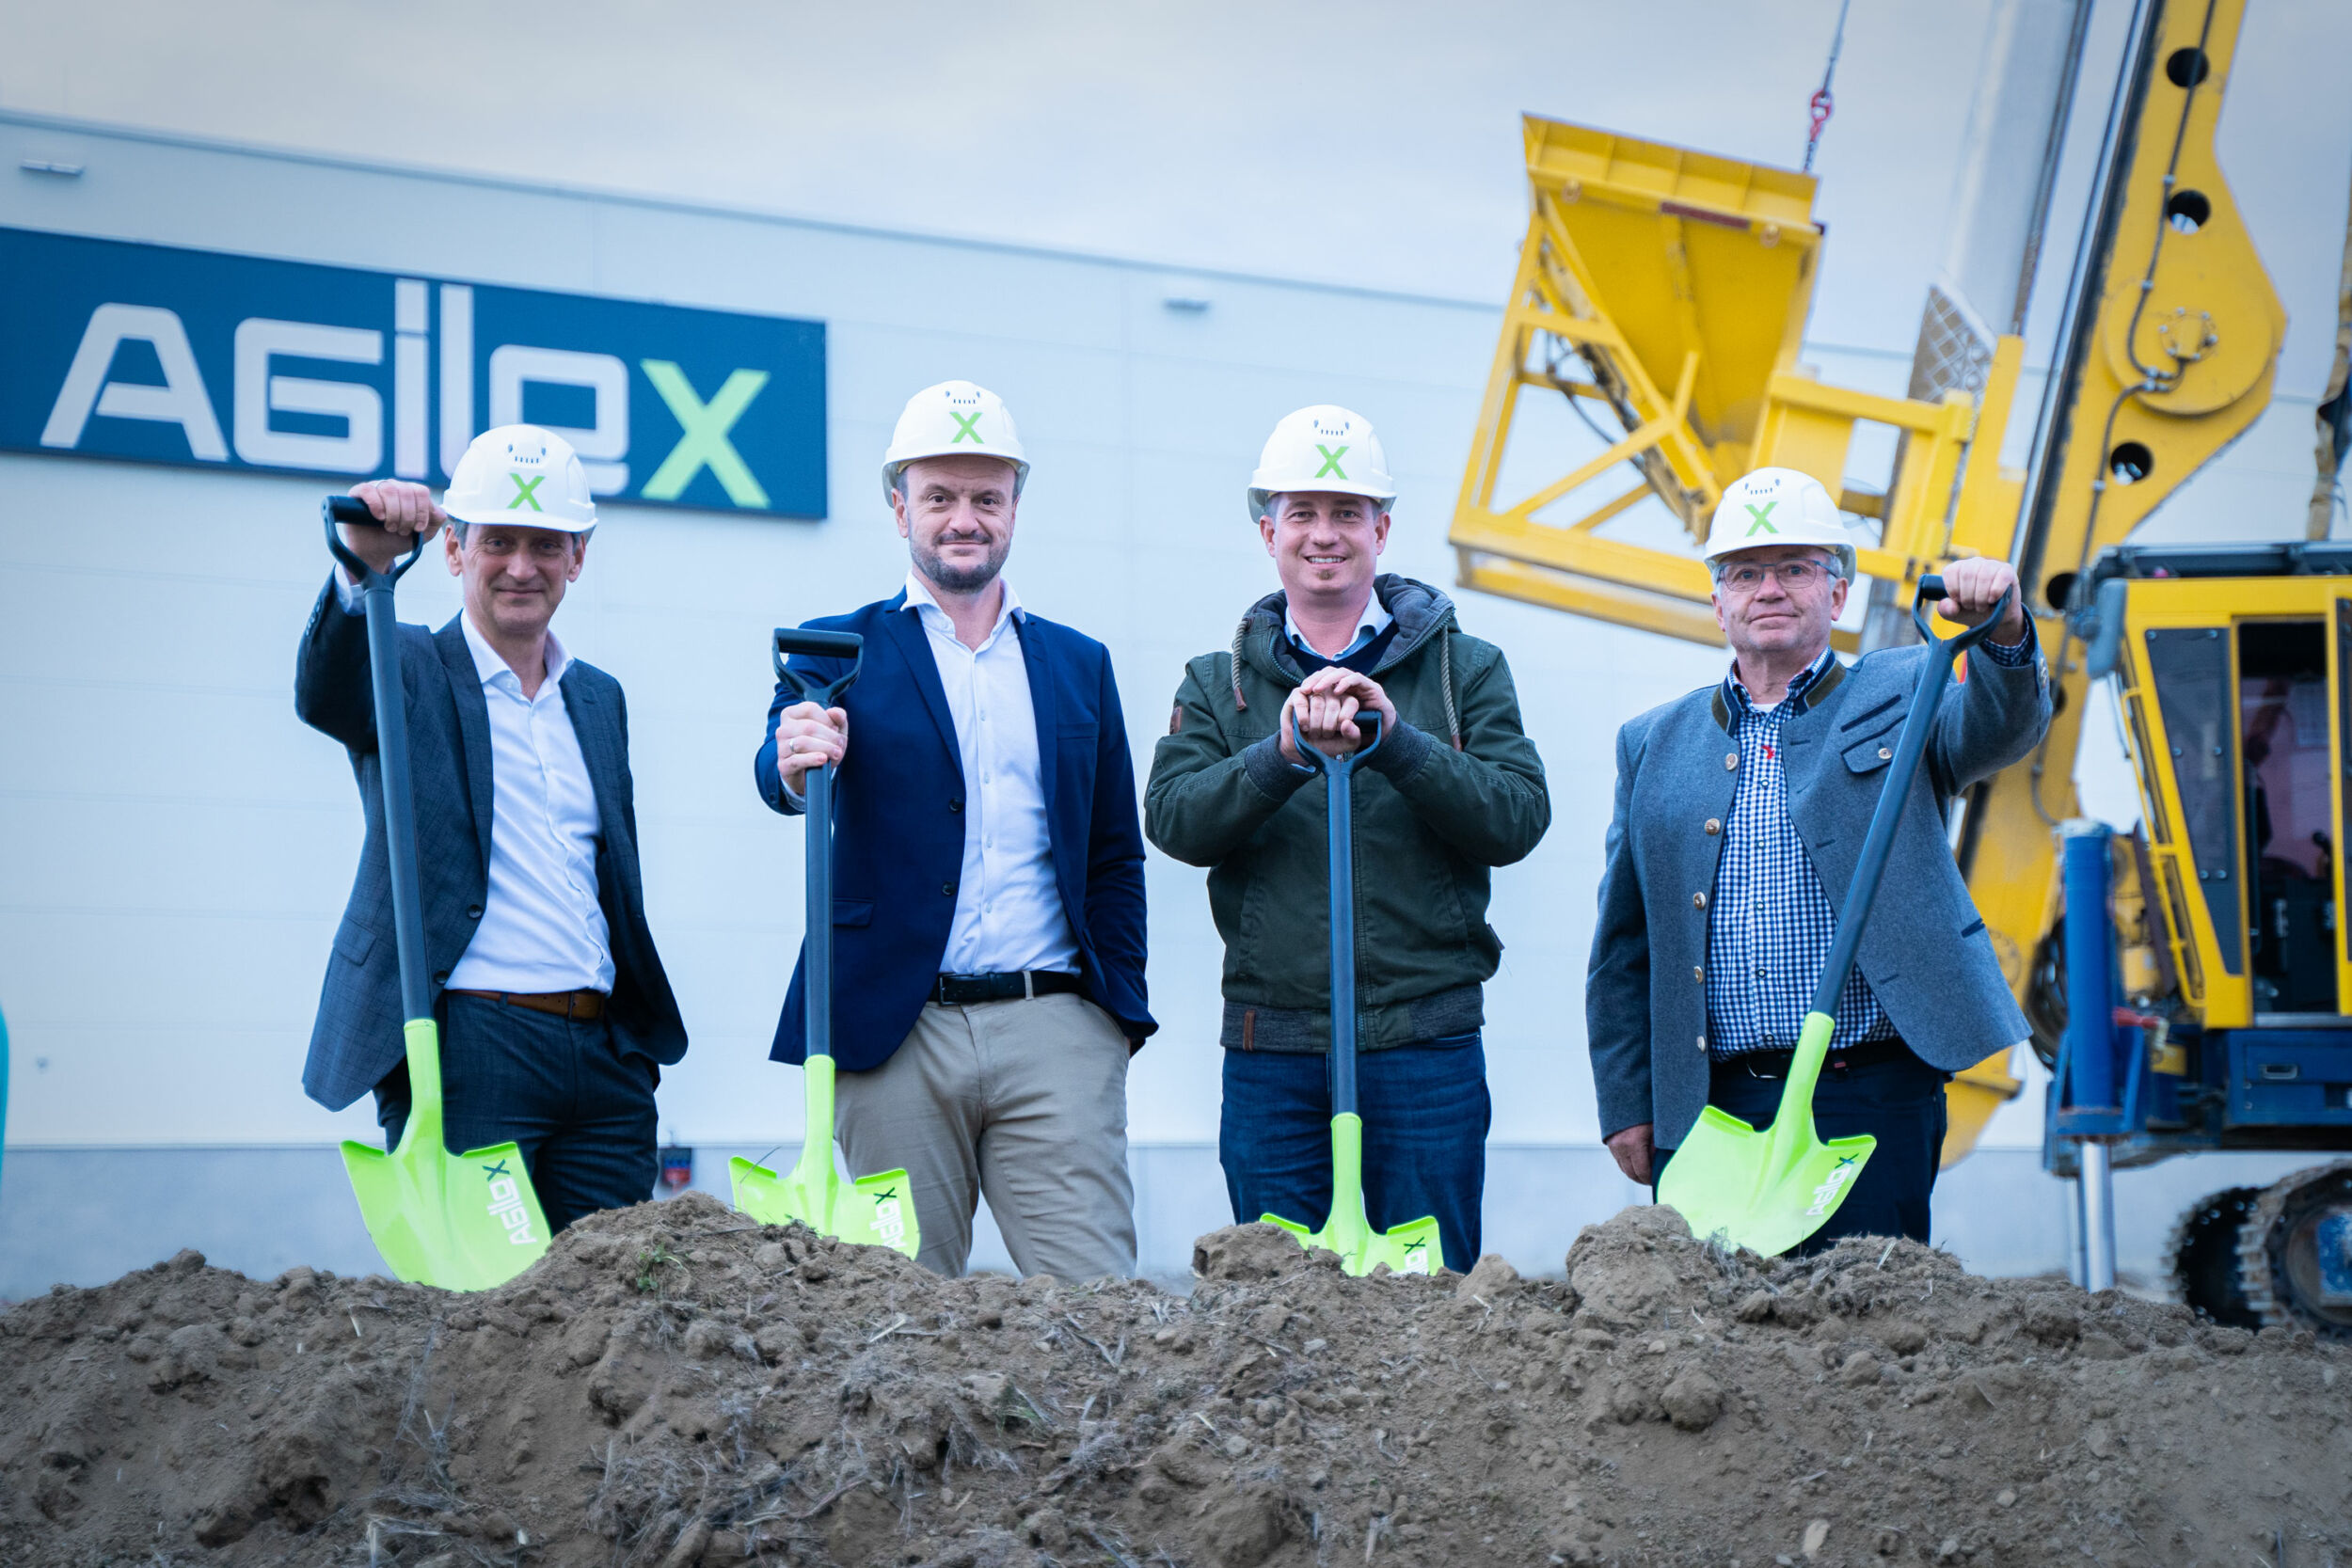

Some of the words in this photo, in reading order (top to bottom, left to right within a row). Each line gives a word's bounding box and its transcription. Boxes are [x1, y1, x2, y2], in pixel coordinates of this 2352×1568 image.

[948, 411, 984, 444] X
[1314, 444, 1349, 480] X
[506, 472, 546, 512] X
[1744, 501, 1779, 537] X
